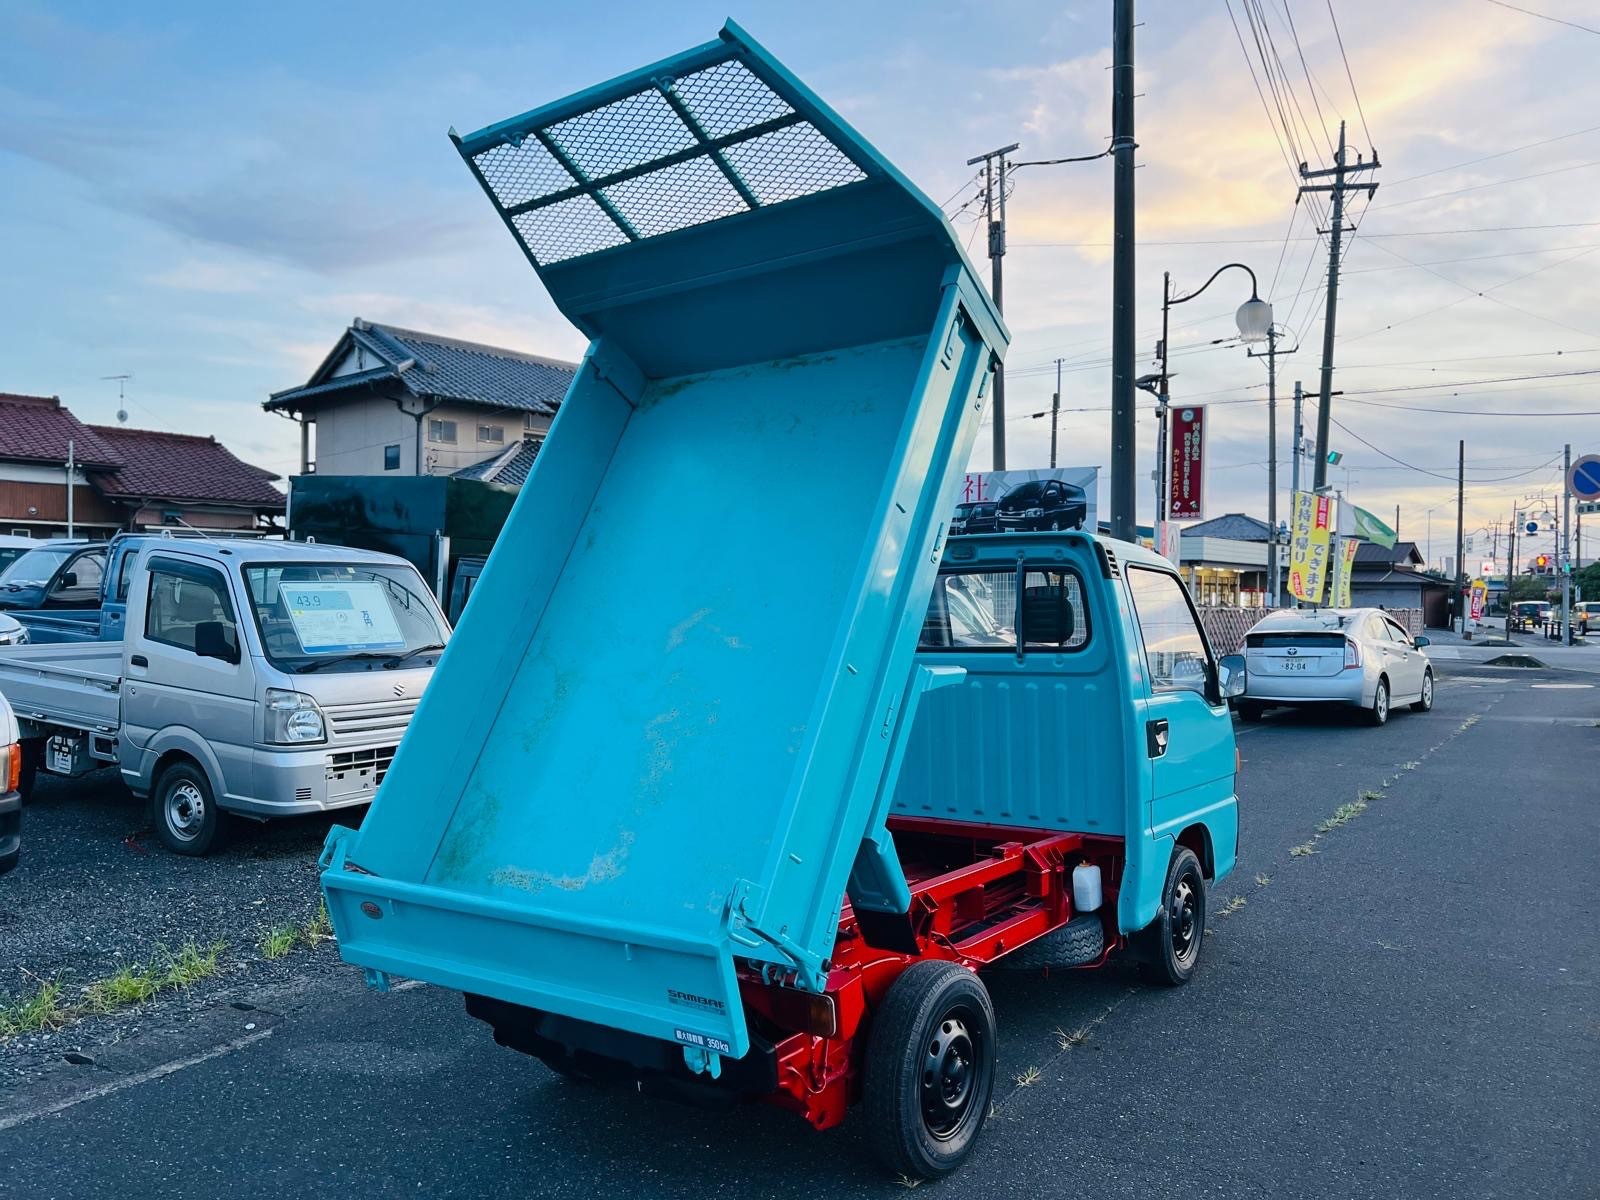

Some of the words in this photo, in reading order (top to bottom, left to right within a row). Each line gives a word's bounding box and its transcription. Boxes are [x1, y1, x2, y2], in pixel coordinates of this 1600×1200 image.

[960, 474, 988, 503] 社
[1295, 495, 1312, 563] お持ち帰り
[1318, 512, 1327, 526] OUT
[1305, 543, 1325, 599] できます
[296, 595, 321, 607] 43.9
[707, 1038, 729, 1053] 350kg
